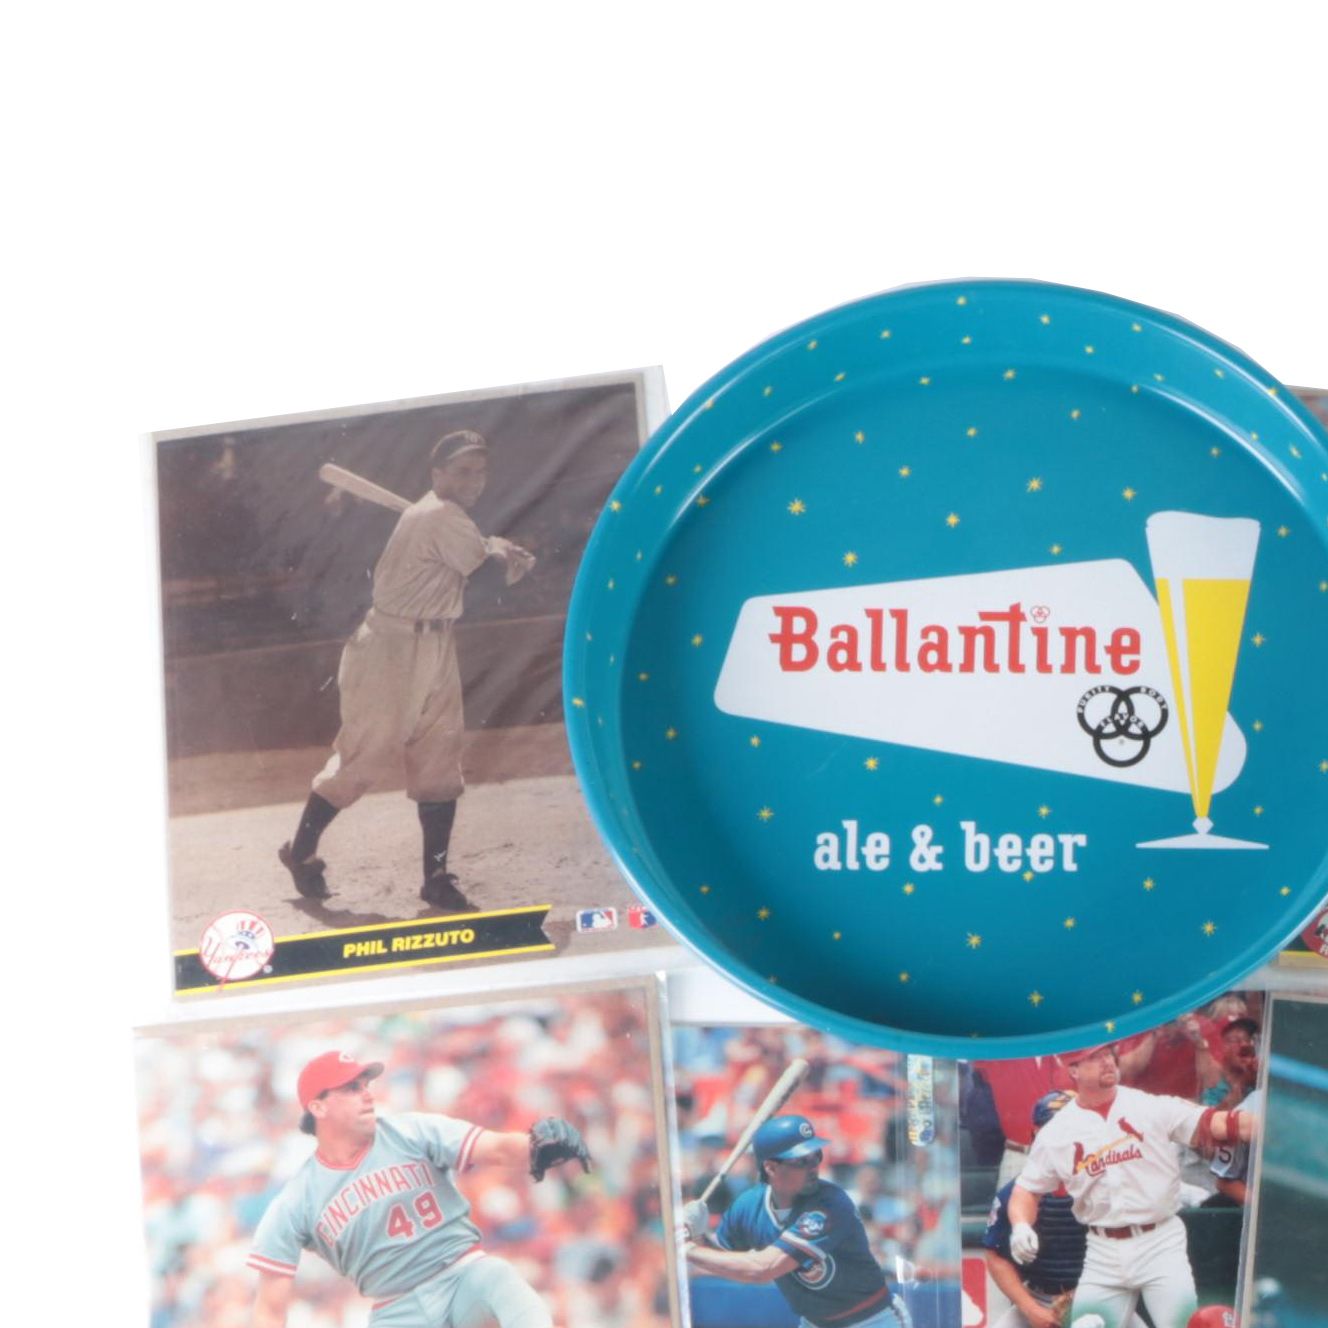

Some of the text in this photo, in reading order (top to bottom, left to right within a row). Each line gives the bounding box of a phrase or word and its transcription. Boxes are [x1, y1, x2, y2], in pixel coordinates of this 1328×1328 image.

[768, 602, 1141, 675] Ballantine
[1140, 686, 1168, 709] BODY
[814, 820, 1087, 872] ale & beer
[342, 928, 475, 959] PHIL RIZZUTO
[319, 1161, 434, 1246] CINCINNATI
[384, 1191, 447, 1242] 49
